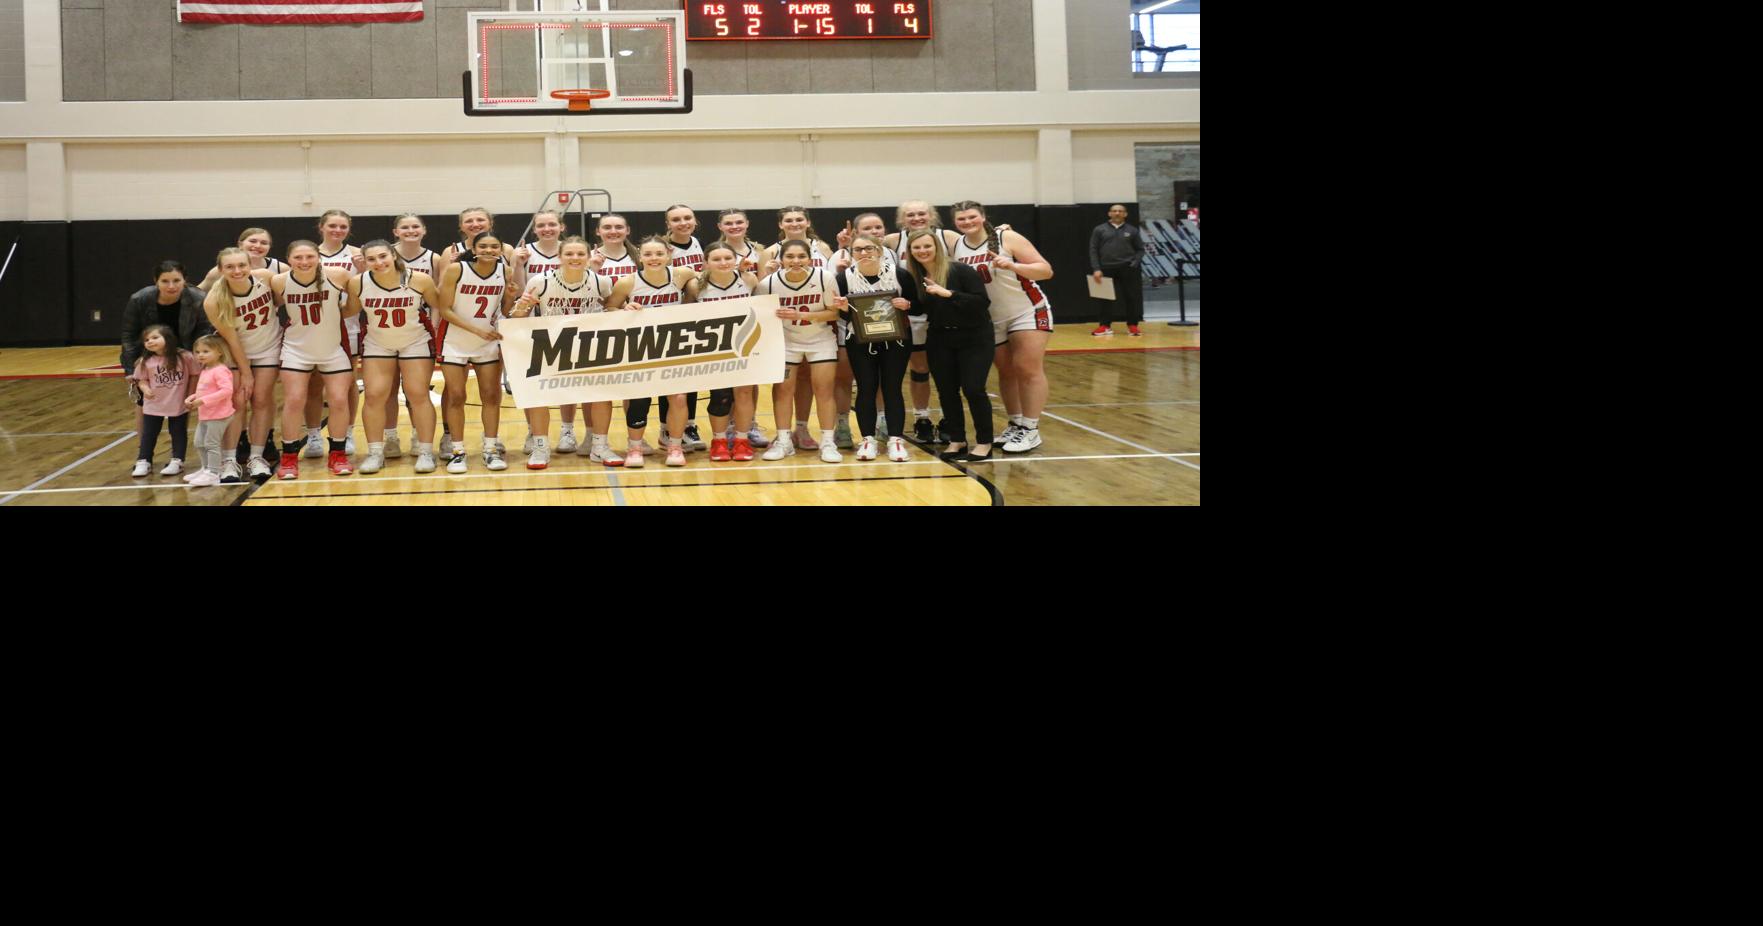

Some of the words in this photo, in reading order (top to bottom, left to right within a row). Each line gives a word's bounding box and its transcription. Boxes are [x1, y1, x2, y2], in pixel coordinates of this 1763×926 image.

[704, 5, 725, 15] FLS
[743, 5, 762, 15] TOL
[789, 5, 830, 15] PLAYER
[855, 4, 874, 14] TOL
[894, 4, 915, 14] FLS
[715, 18, 729, 36] 5
[747, 18, 760, 35] 2
[868, 18, 873, 33] 1
[904, 18, 918, 33] 4
[298, 303, 321, 326] 10
[374, 308, 406, 328] 20
[474, 296, 487, 318] 2
[526, 315, 748, 378] MIDWEST
[538, 370, 655, 390] TOURNAMENT
[660, 359, 748, 380] CHAMPION
